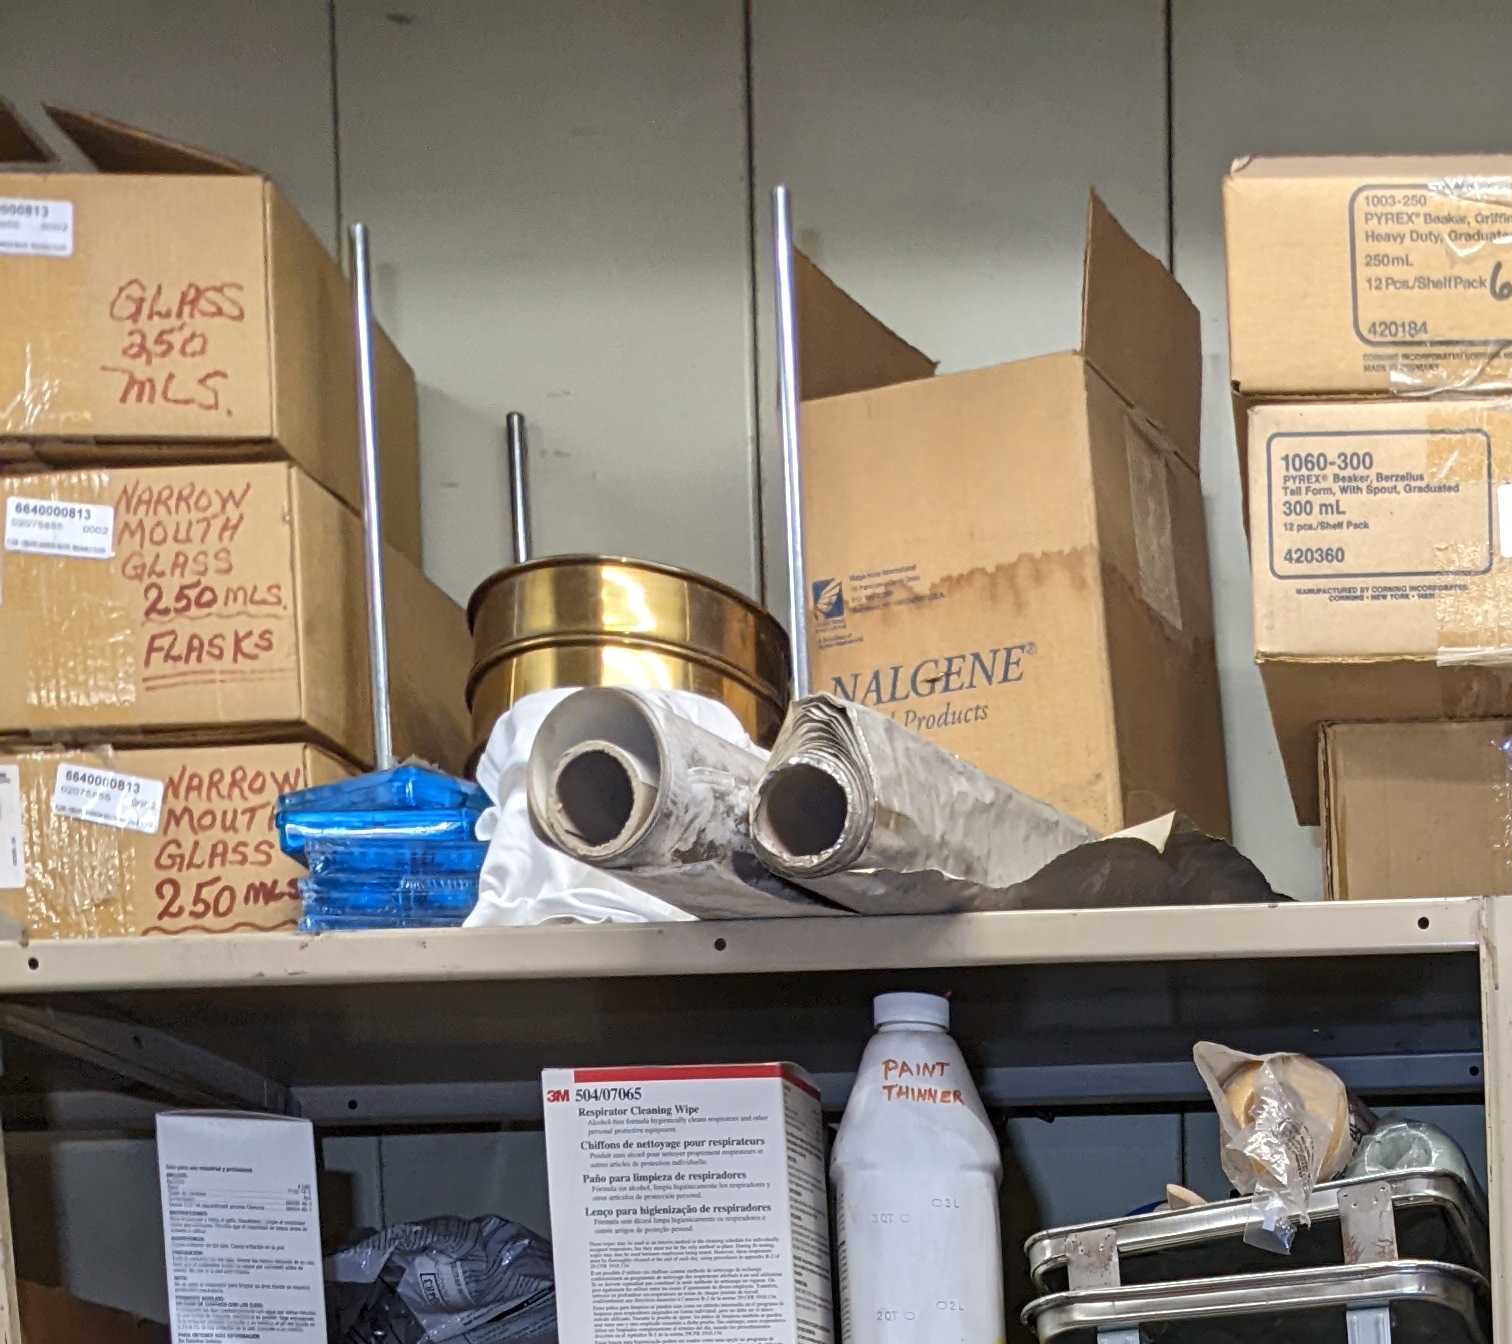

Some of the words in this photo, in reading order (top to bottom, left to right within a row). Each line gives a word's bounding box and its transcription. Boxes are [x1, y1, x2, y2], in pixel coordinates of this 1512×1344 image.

[1365, 195, 1427, 207] 1003-250
[1365, 230, 1404, 244] Heavy
[110, 278, 244, 322] GLASS
[1368, 322, 1428, 337] 420184
[1281, 453, 1373, 471] 1060-300
[117, 482, 250, 516] NARROW
[1283, 501, 1314, 517] 300
[1317, 500, 1346, 517] mL
[15, 503, 91, 520] 6640000813
[118, 516, 243, 545] MOUTH
[121, 548, 233, 580] GLASS
[1283, 547, 1345, 565] 420360
[144, 582, 215, 620] 250
[144, 629, 273, 667] FLASKS
[905, 702, 988, 732] Products
[165, 765, 301, 804] NARROW
[156, 840, 273, 872] GLASS
[156, 878, 235, 920] 250
[882, 1058, 951, 1082] PAINT
[547, 1090, 570, 1102] 3M
[576, 1087, 642, 1102] 504/07065
[882, 1083, 965, 1104] THINNER
[578, 1107, 628, 1118] Respirator
[630, 1106, 673, 1116] Cleaning
[674, 1105, 700, 1115] Wipe
[580, 1140, 620, 1150] Chiffons
[622, 1140, 634, 1149] de
[636, 1139, 681, 1151] nettoyage
[683, 1138, 706, 1149] pour
[708, 1137, 765, 1148] respirateurs
[608, 1174, 631, 1184] para
[633, 1172, 673, 1184] limpieza
[675, 1172, 686, 1181] de
[688, 1171, 746, 1182] respiradores
[616, 1207, 638, 1217] para
[700, 1204, 711, 1214] de
[713, 1203, 771, 1215] respiradores
